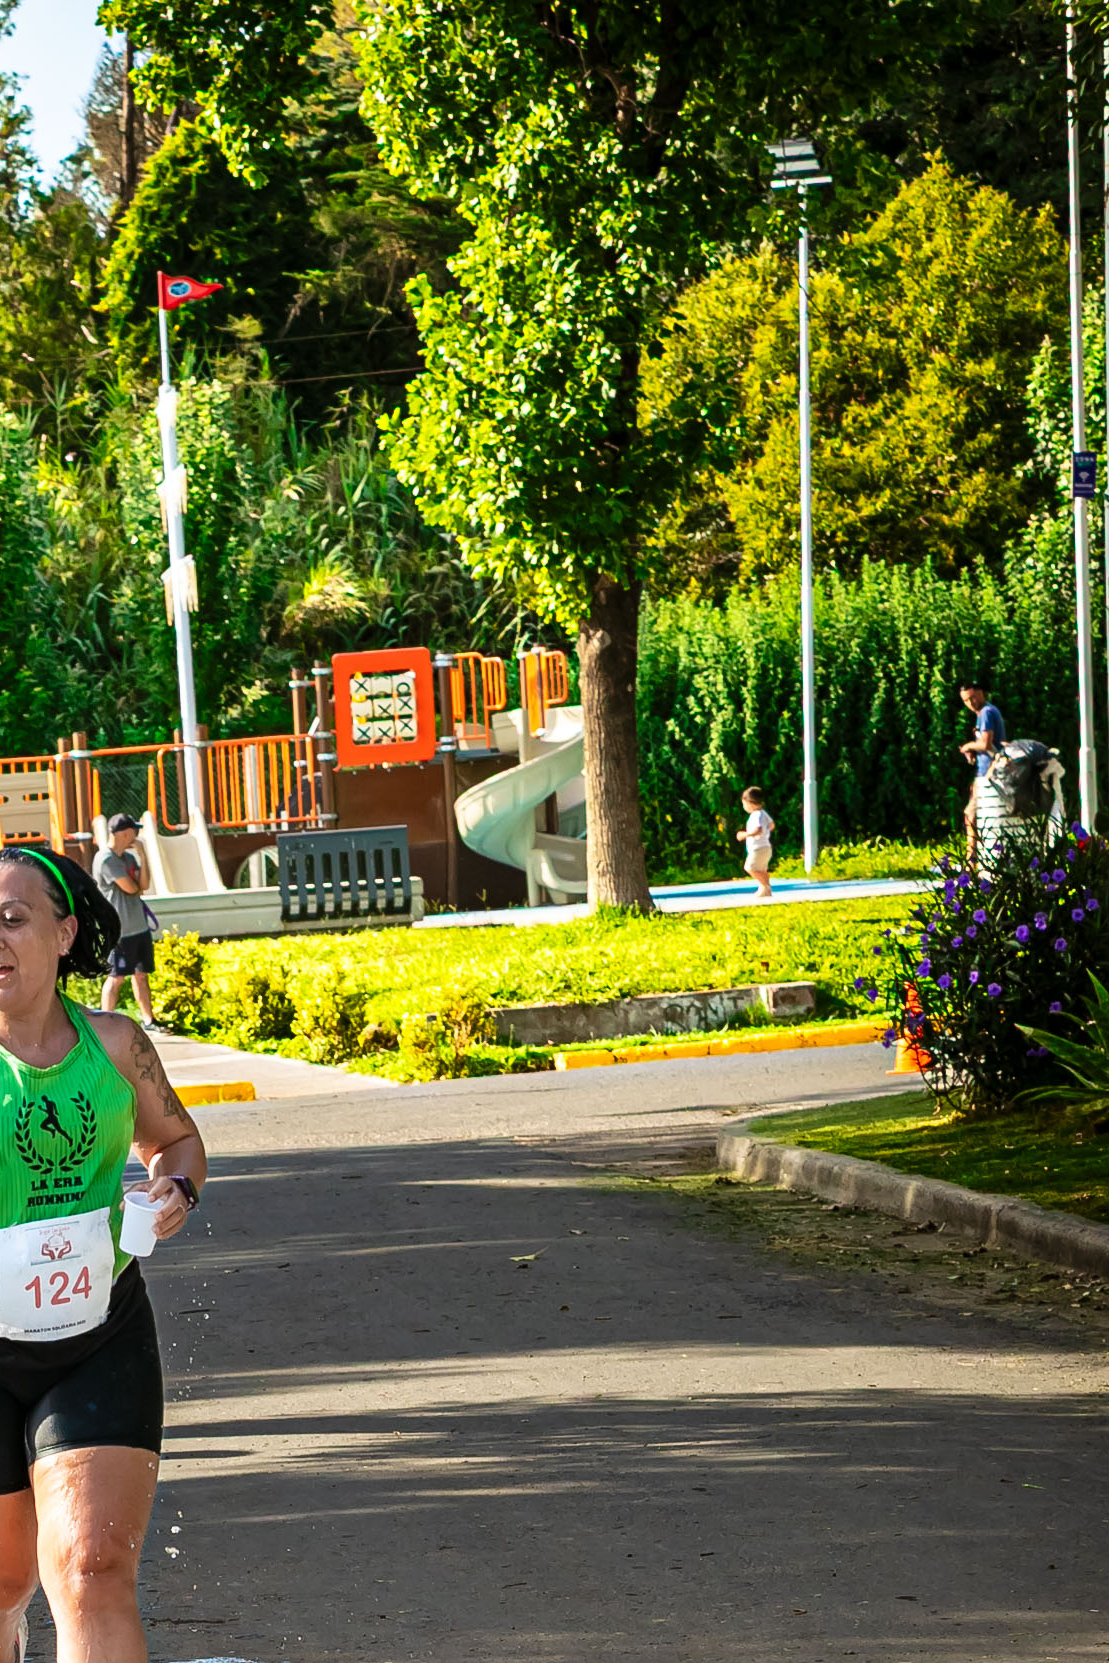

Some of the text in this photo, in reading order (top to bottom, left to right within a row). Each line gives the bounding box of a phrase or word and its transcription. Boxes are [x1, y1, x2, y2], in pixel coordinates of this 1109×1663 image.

[31, 1176, 84, 1192] LA ERA
[25, 1265, 92, 1309] 124
[51, 1321, 76, 1332] SOLIDARIA
